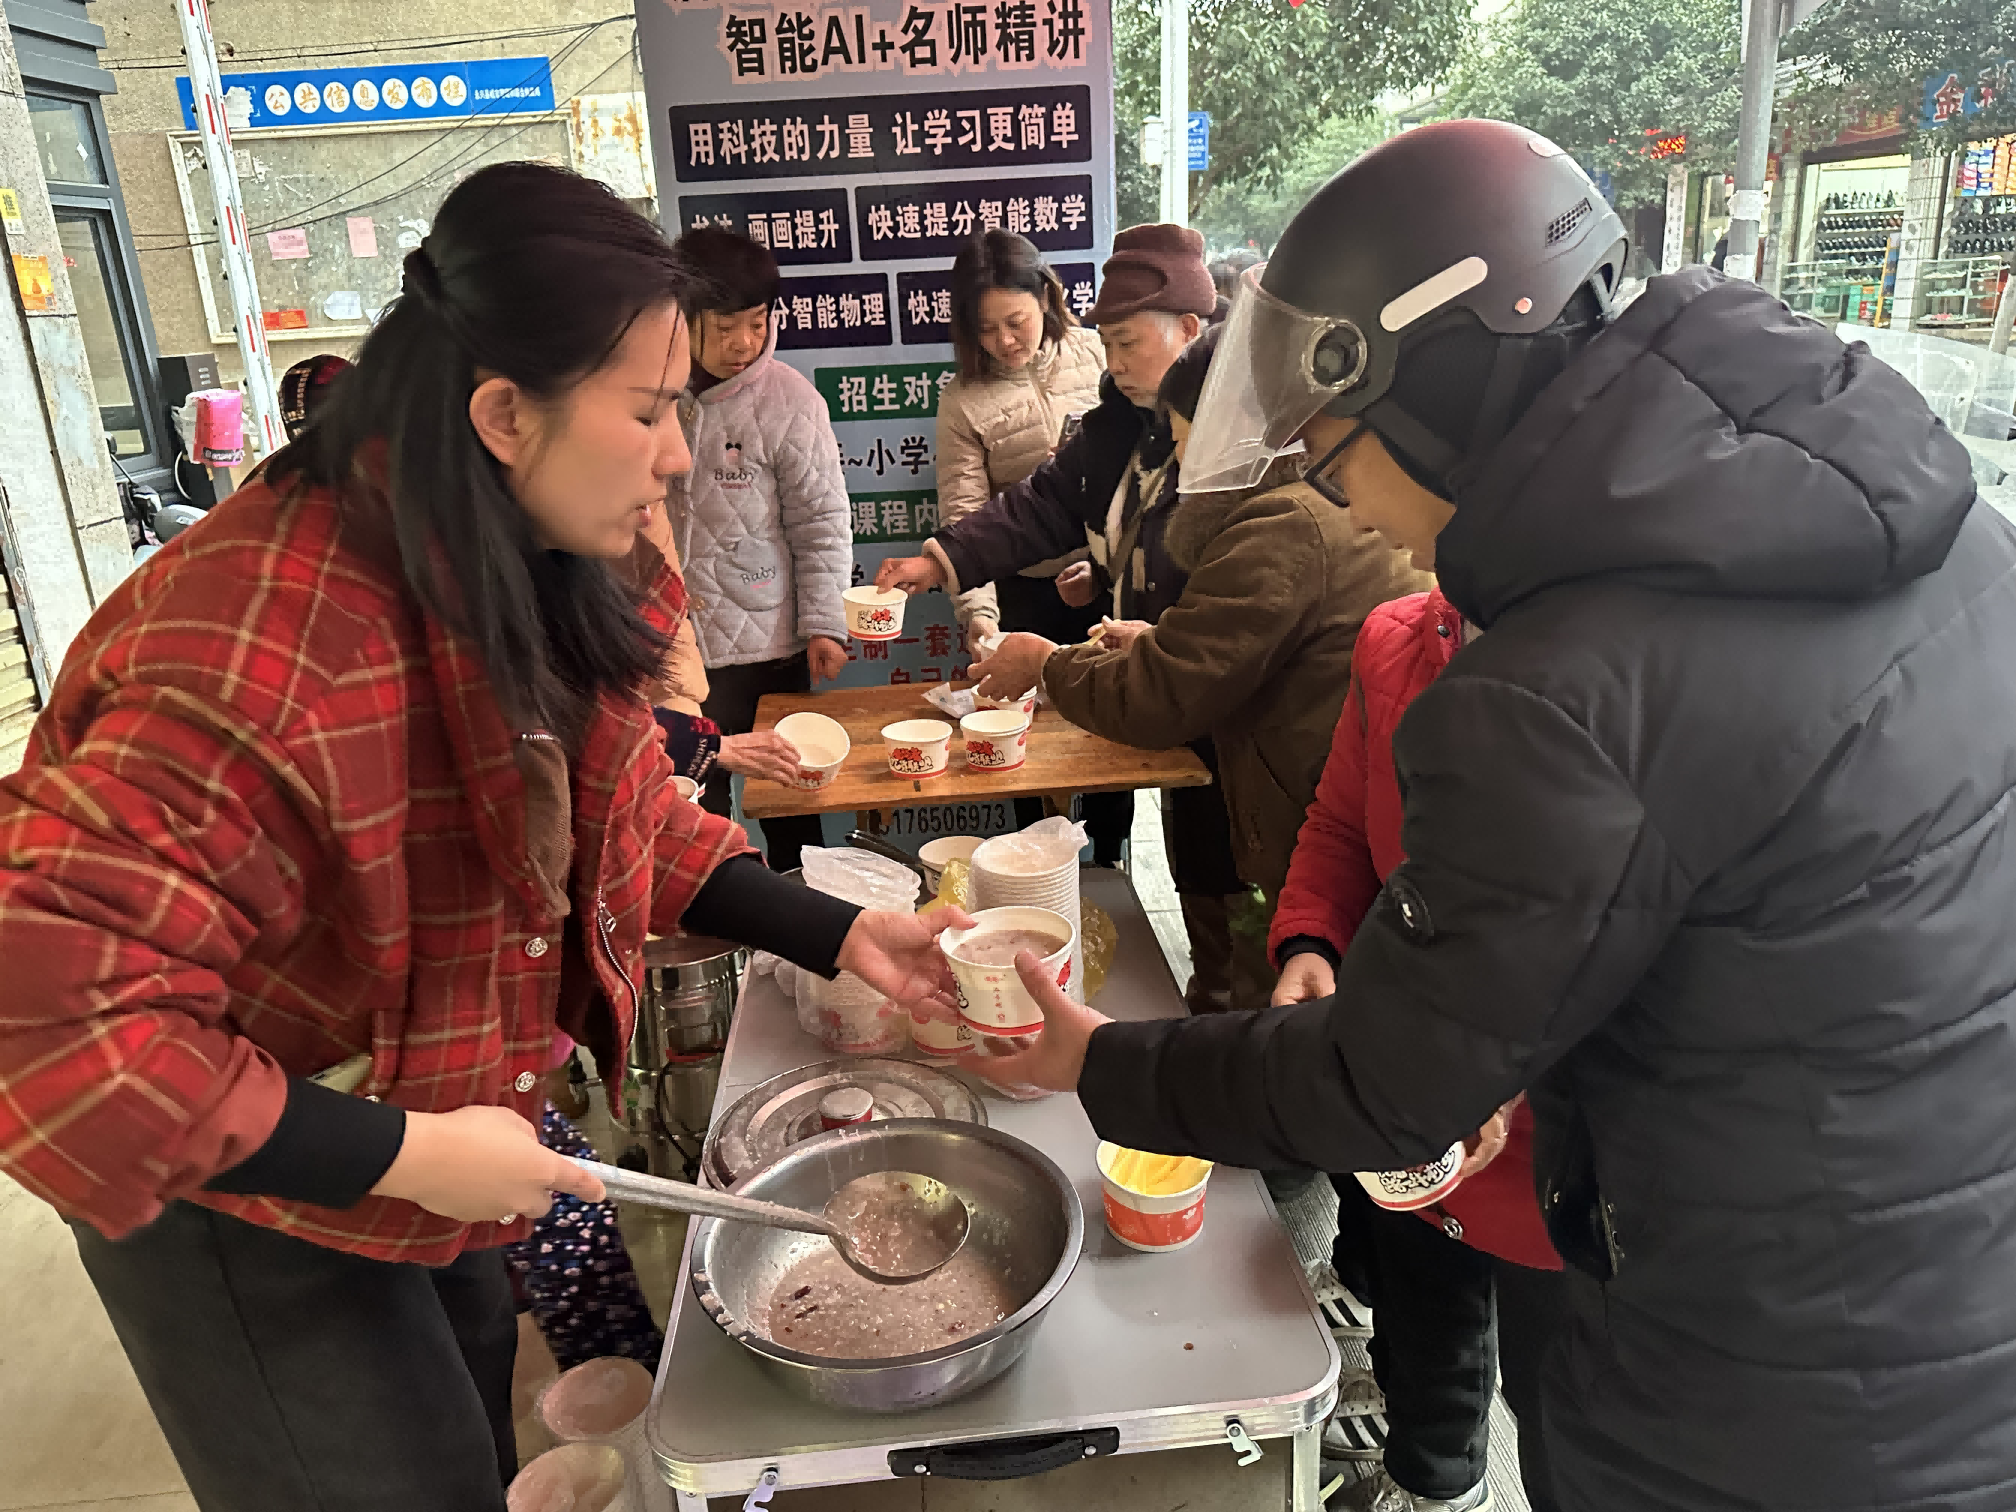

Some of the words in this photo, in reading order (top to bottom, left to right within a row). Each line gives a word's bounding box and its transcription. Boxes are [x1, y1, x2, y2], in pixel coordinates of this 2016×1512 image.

[726, 0, 1086, 76] 智能AI+名师精讲
[267, 79, 466, 113] 公共信息发布栏
[688, 112, 875, 167] 用科技的力量
[891, 102, 1080, 156] 让学习更简单
[867, 194, 1087, 241] 快速提分智能数学
[714, 466, 758, 484] Baby
[851, 497, 939, 535] 课程内
[740, 566, 777, 585] Baby
